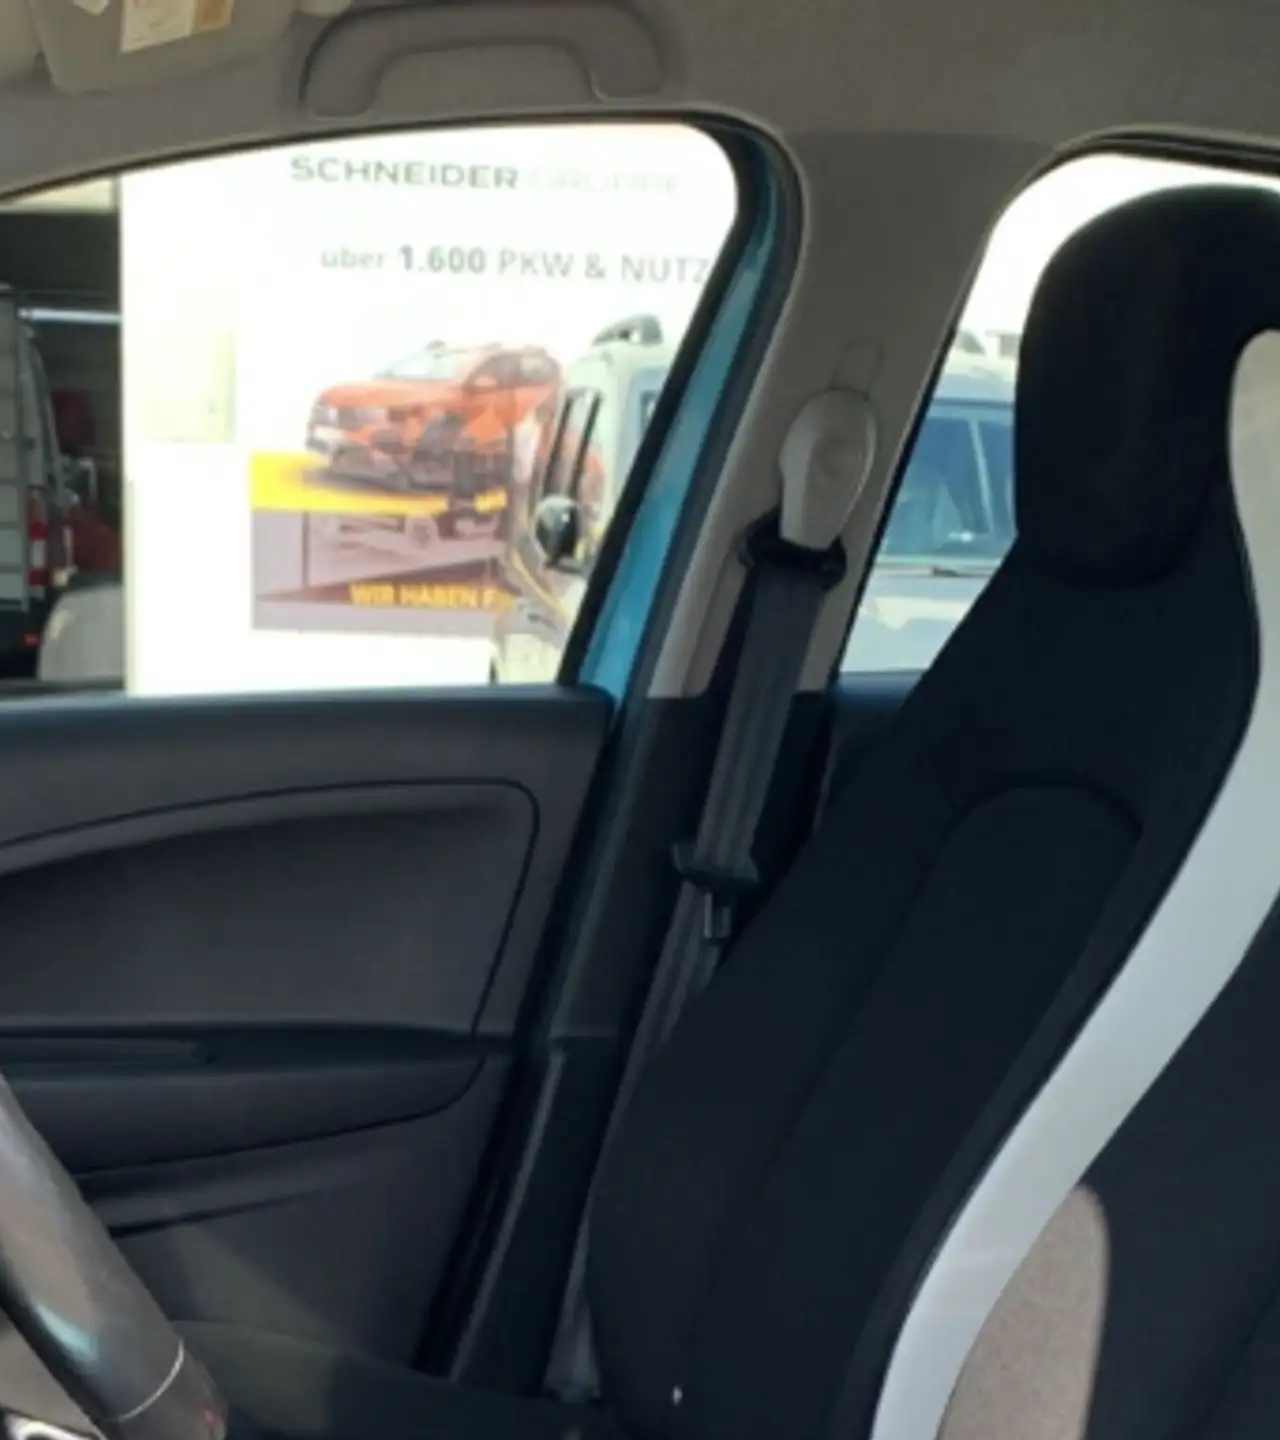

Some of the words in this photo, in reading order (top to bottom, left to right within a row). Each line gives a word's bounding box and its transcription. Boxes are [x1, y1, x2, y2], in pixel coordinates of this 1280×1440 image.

[289, 155, 520, 190] SCHNEIDER
[397, 243, 488, 274] 1.600
[497, 246, 575, 279] PKW
[584, 251, 607, 280] &
[350, 582, 395, 606] WIR
[399, 583, 479, 609] HABEN
